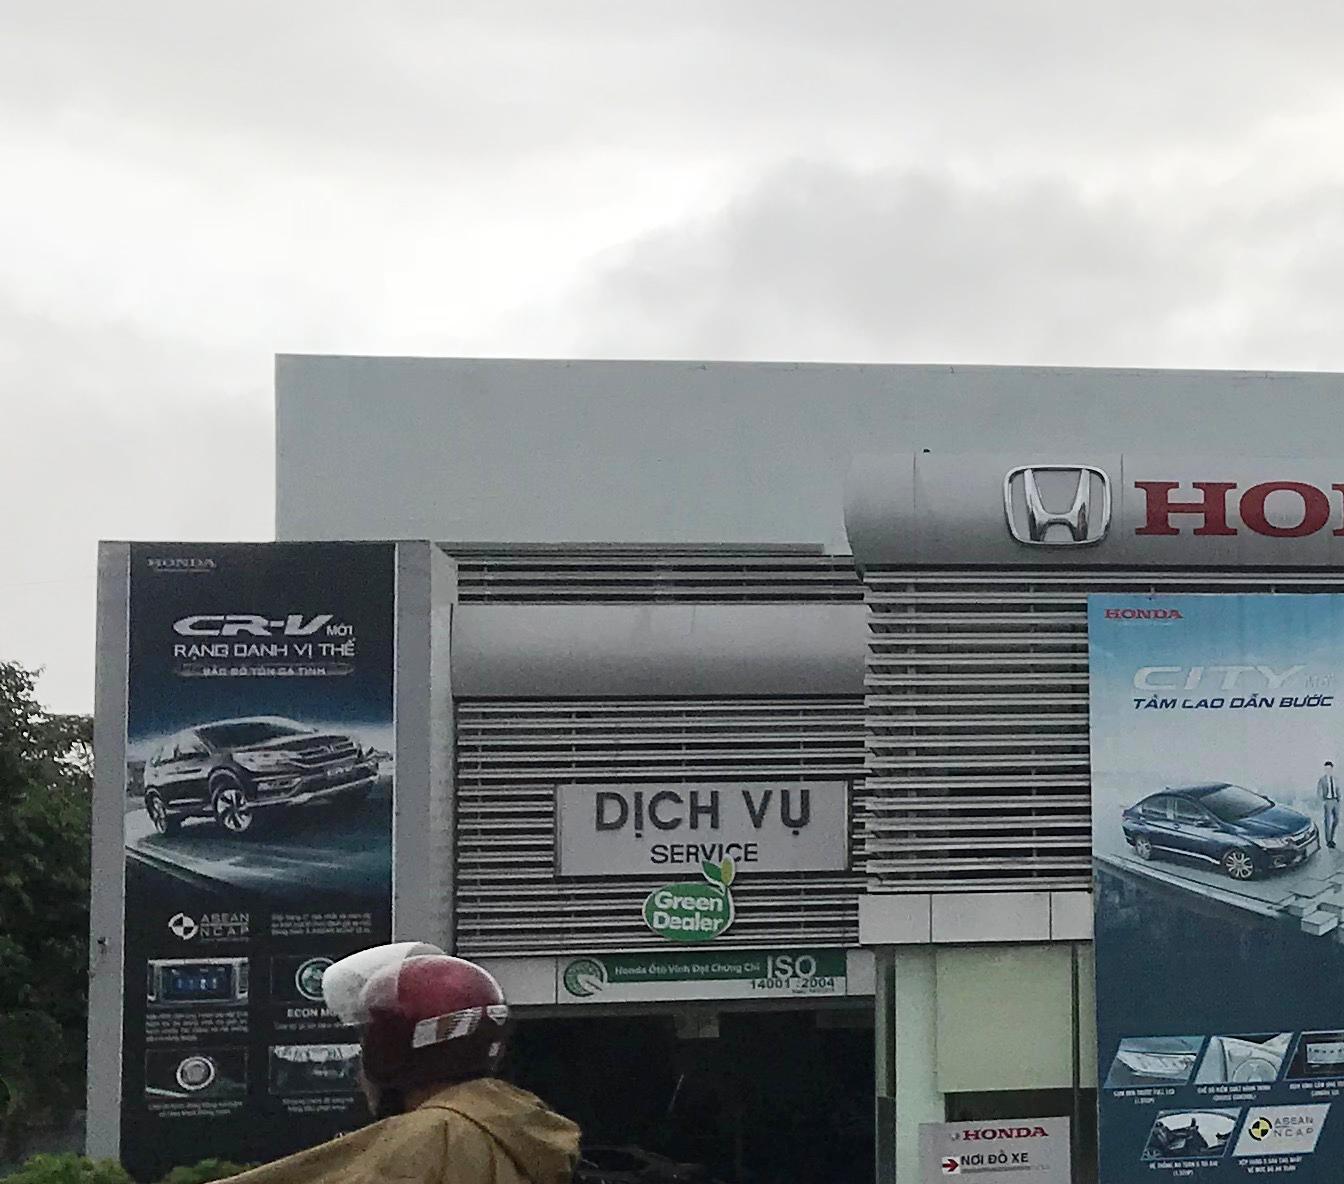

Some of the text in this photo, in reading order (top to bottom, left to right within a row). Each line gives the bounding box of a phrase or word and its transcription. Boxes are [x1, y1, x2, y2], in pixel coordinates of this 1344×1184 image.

[1104, 608, 1183, 619] HONDA
[172, 614, 334, 636] CR-V
[174, 637, 356, 660] RẠNG DANH VỊ THẾ
[1133, 665, 1306, 690] CITY
[1182, 698, 1225, 709] CAO
[1229, 692, 1274, 708] DẪN
[1279, 693, 1335, 708] BƯỚC
[595, 789, 811, 838] DỊCH VỤ
[650, 843, 759, 864] SERVICE
[654, 891, 724, 912] Green
[200, 912, 249, 923] ASEAN
[652, 911, 725, 932] Dealer
[200, 926, 249, 937] NCAP
[615, 965, 647, 976] Honda
[668, 963, 690, 975] Vinh
[767, 955, 817, 979] ISO
[286, 1008, 318, 1018] ECON
[1274, 1116, 1314, 1127] ASEAN
[962, 1127, 1049, 1141] HONDA
[1273, 1127, 1314, 1138] NCAP
[1011, 1152, 1029, 1164] XE
